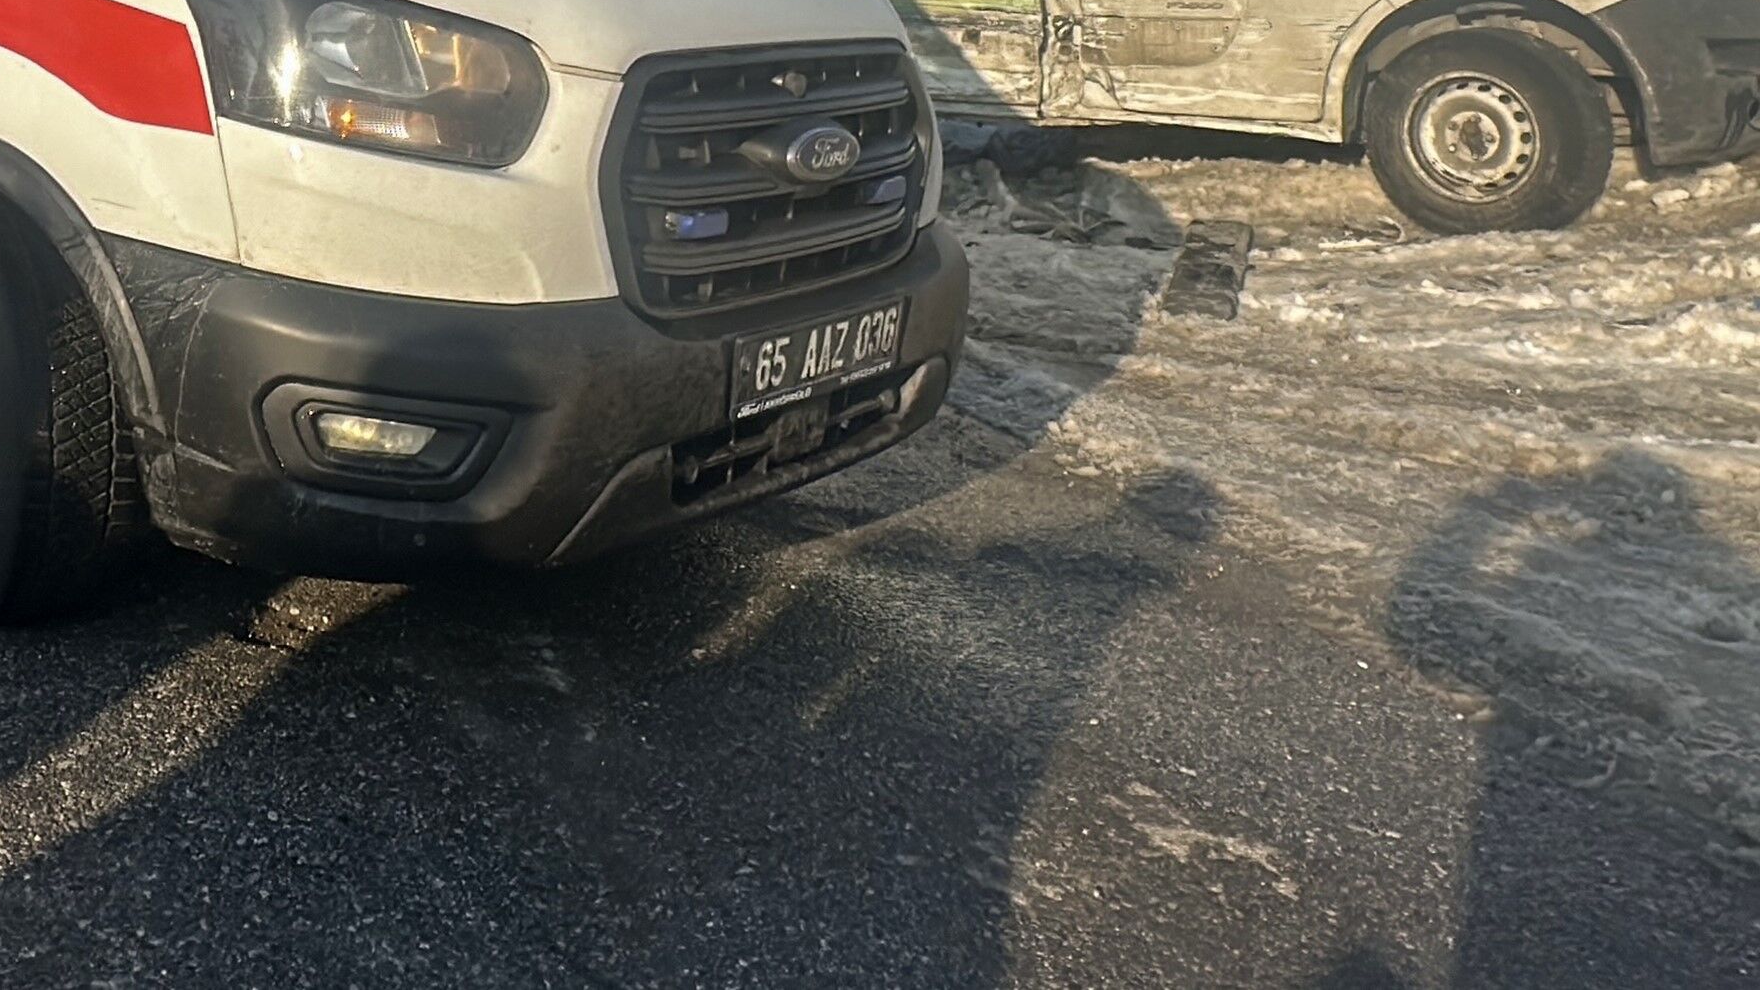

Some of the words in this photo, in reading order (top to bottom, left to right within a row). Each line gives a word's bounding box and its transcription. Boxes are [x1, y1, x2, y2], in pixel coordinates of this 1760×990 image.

[811, 137, 850, 170] Ford
[755, 337, 790, 391] 65
[801, 321, 849, 379] AAZ
[854, 307, 897, 362] 036
